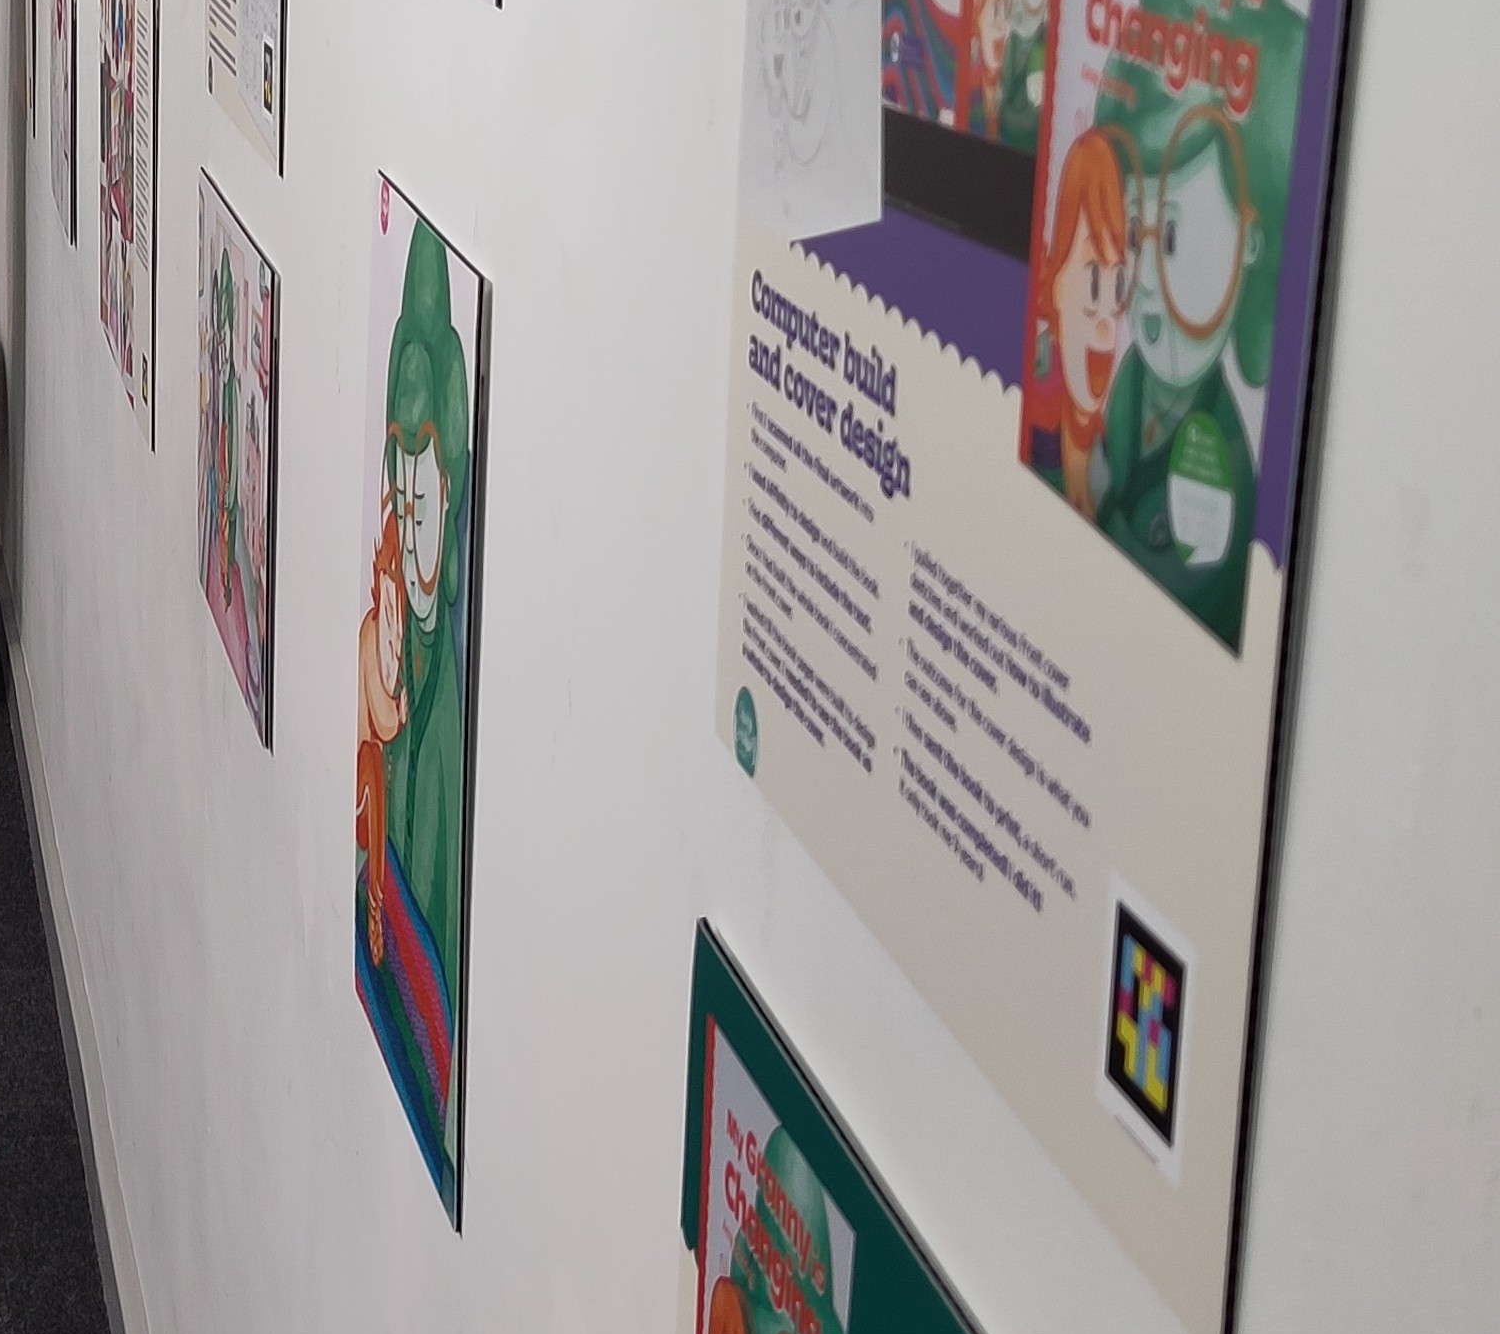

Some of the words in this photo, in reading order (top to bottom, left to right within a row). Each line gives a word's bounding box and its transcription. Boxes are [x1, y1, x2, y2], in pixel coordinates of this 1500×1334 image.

[749, 339, 780, 386] and
[784, 368, 836, 433] cover
[840, 406, 911, 494] design
[752, 271, 838, 370] Computer
[843, 337, 896, 410] build
[726, 1112, 743, 1161] My
[745, 1130, 811, 1276] Granny
